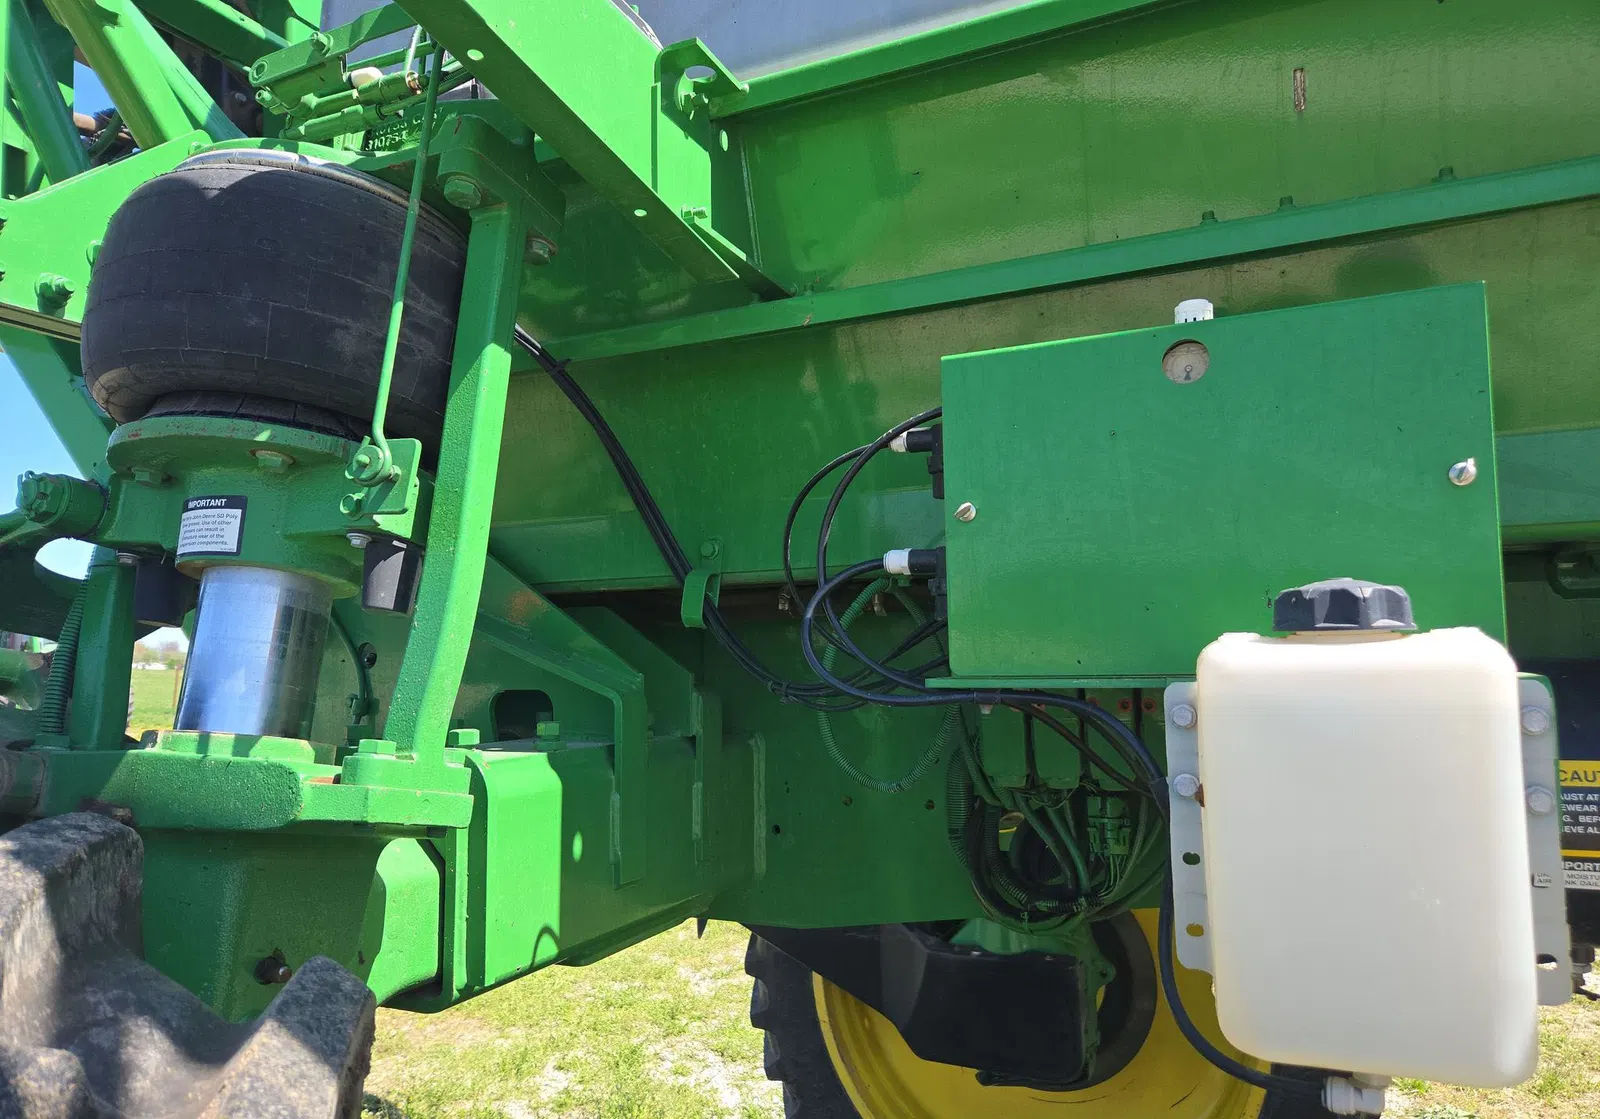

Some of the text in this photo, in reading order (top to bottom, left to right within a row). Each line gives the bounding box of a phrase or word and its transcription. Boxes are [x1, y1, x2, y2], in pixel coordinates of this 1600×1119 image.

[1560, 792, 1600, 802] UST AT
[1578, 815, 1600, 823] BEF
